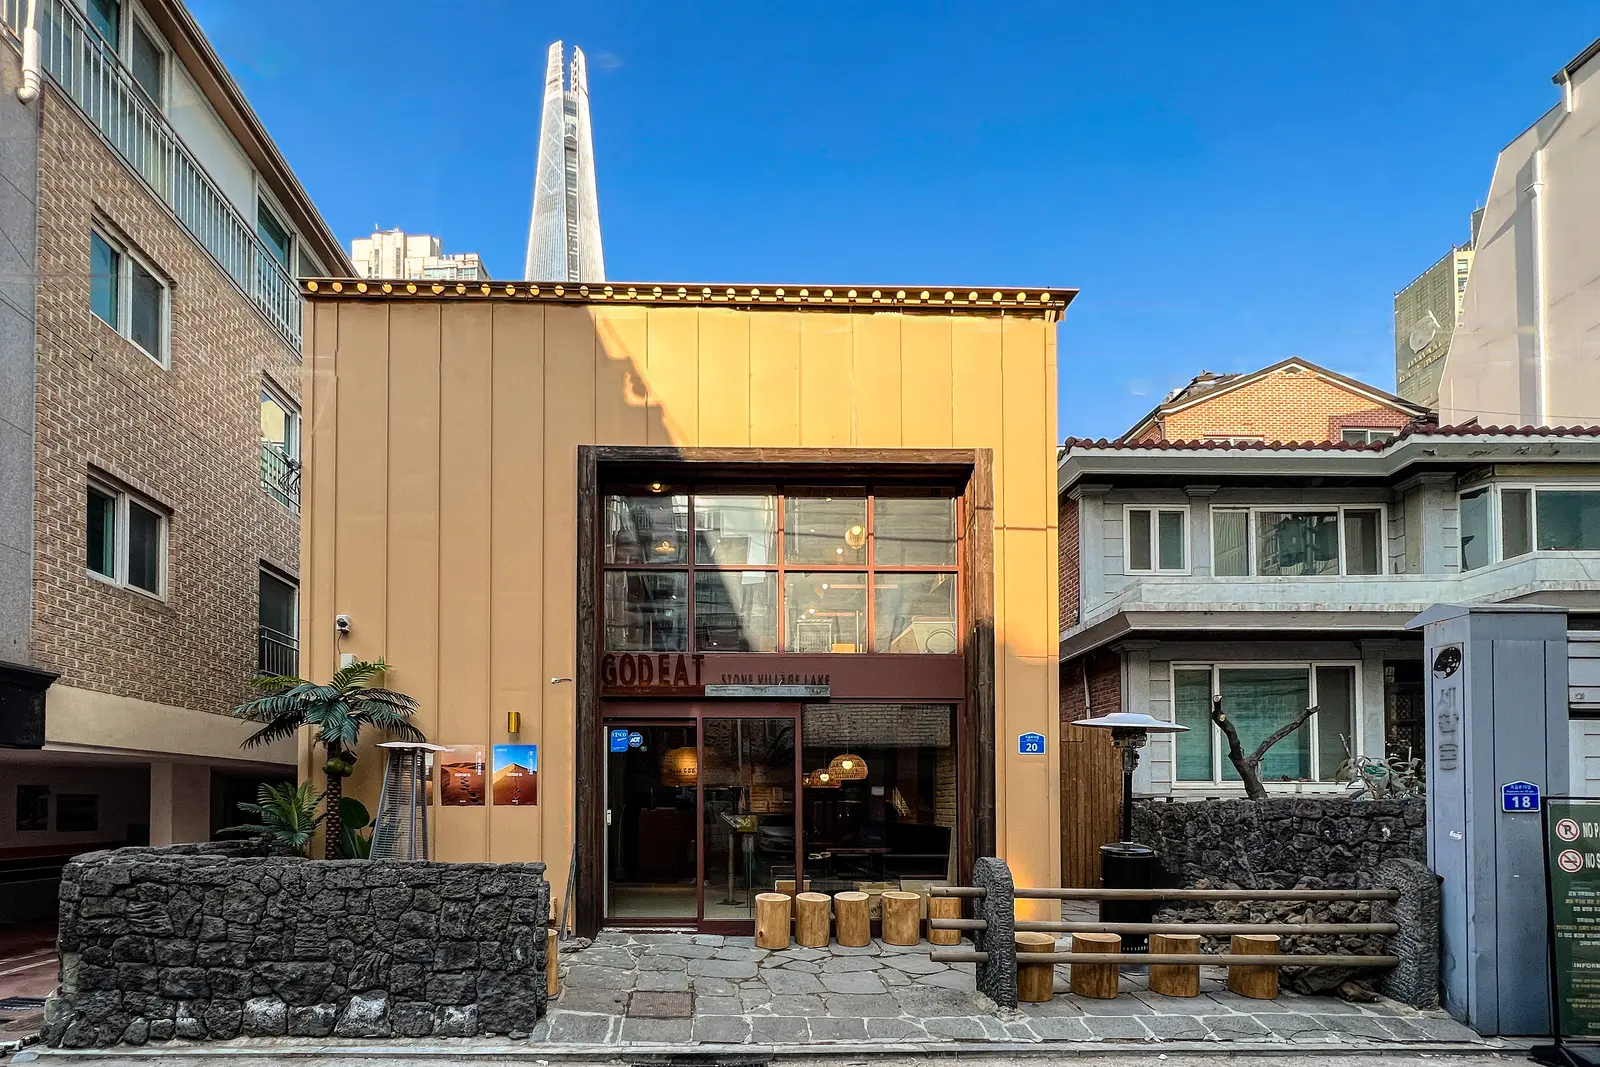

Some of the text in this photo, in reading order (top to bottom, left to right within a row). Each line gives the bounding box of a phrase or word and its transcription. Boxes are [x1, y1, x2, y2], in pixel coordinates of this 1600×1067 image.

[721, 673, 831, 685] STONE VILLAGE LAKE
[1026, 743, 1038, 751] 20
[1512, 795, 1531, 808] 18
[1582, 822, 1600, 839] NO P
[1585, 853, 1595, 869] NO
